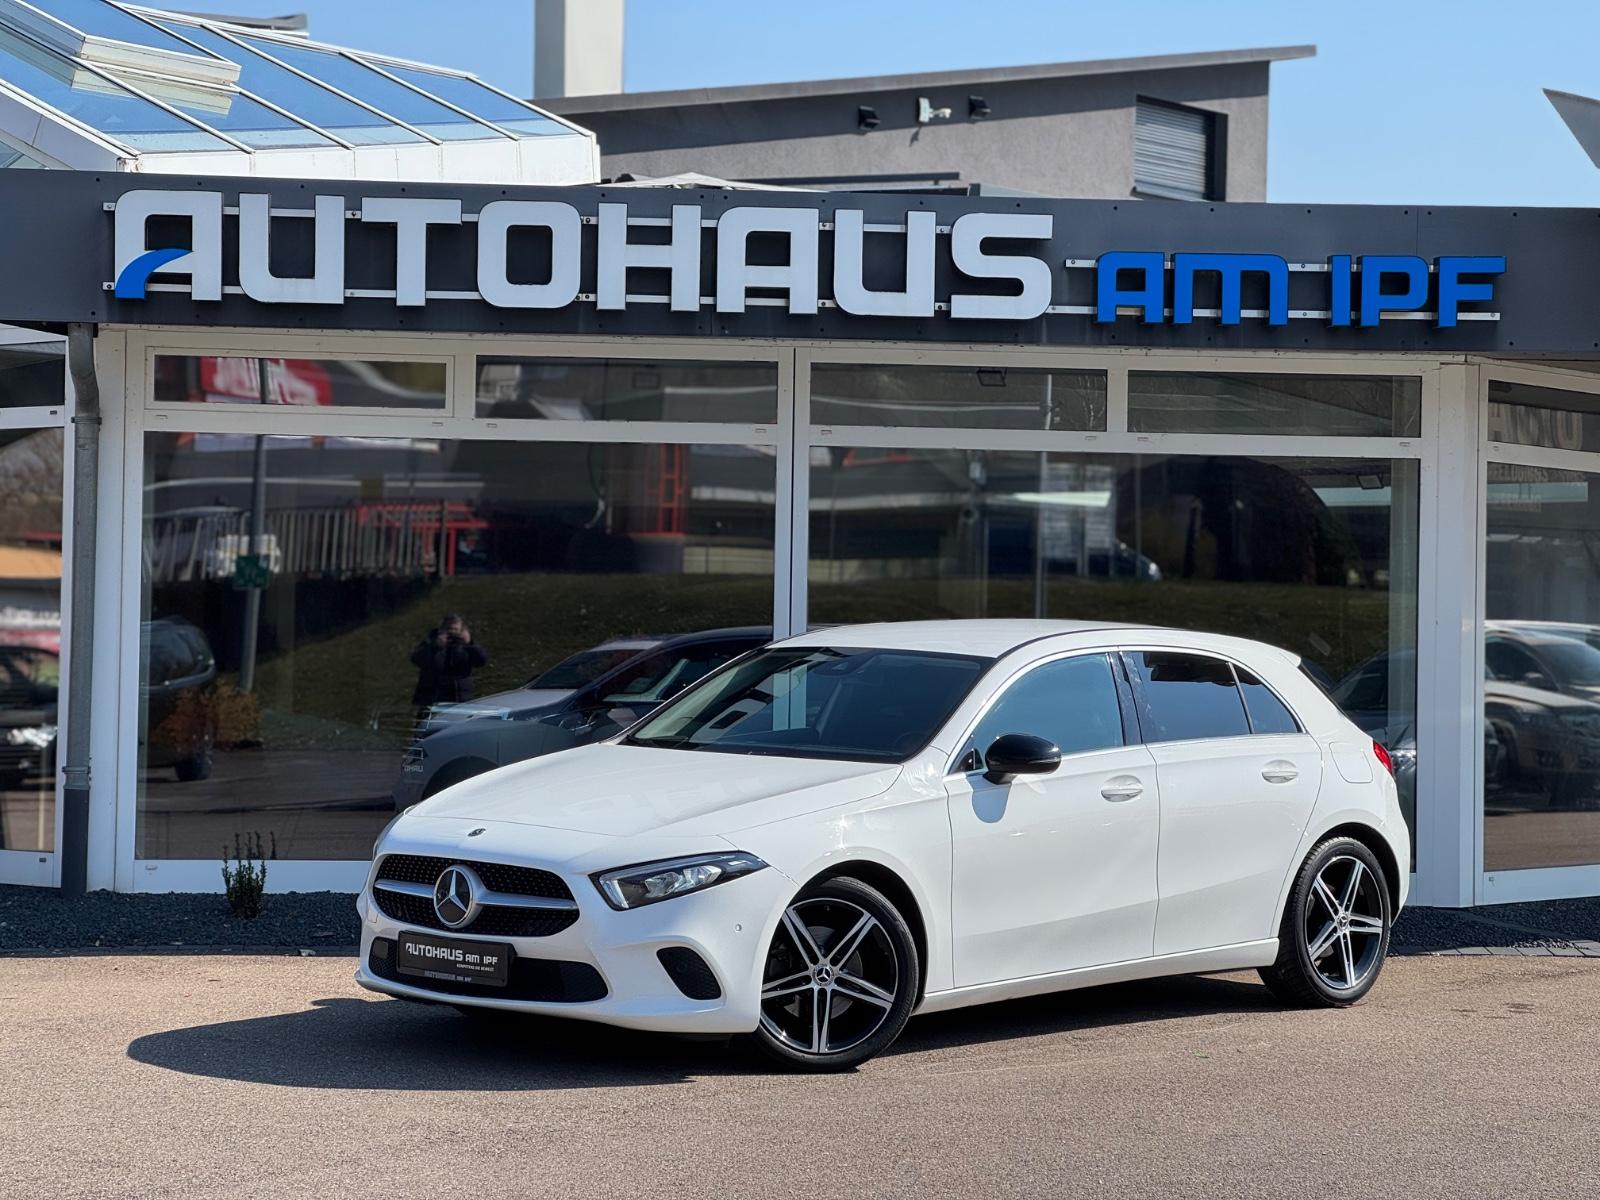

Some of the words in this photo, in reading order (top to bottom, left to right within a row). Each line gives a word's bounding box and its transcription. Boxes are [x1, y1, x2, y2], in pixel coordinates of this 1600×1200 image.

[114, 189, 1053, 320] AUTOHAUS
[1096, 251, 1289, 326] AM
[1330, 254, 1507, 329] IPF
[406, 943, 463, 961] AUTOHAUS
[465, 954, 480, 964] AM
[483, 956, 498, 966] IPF
